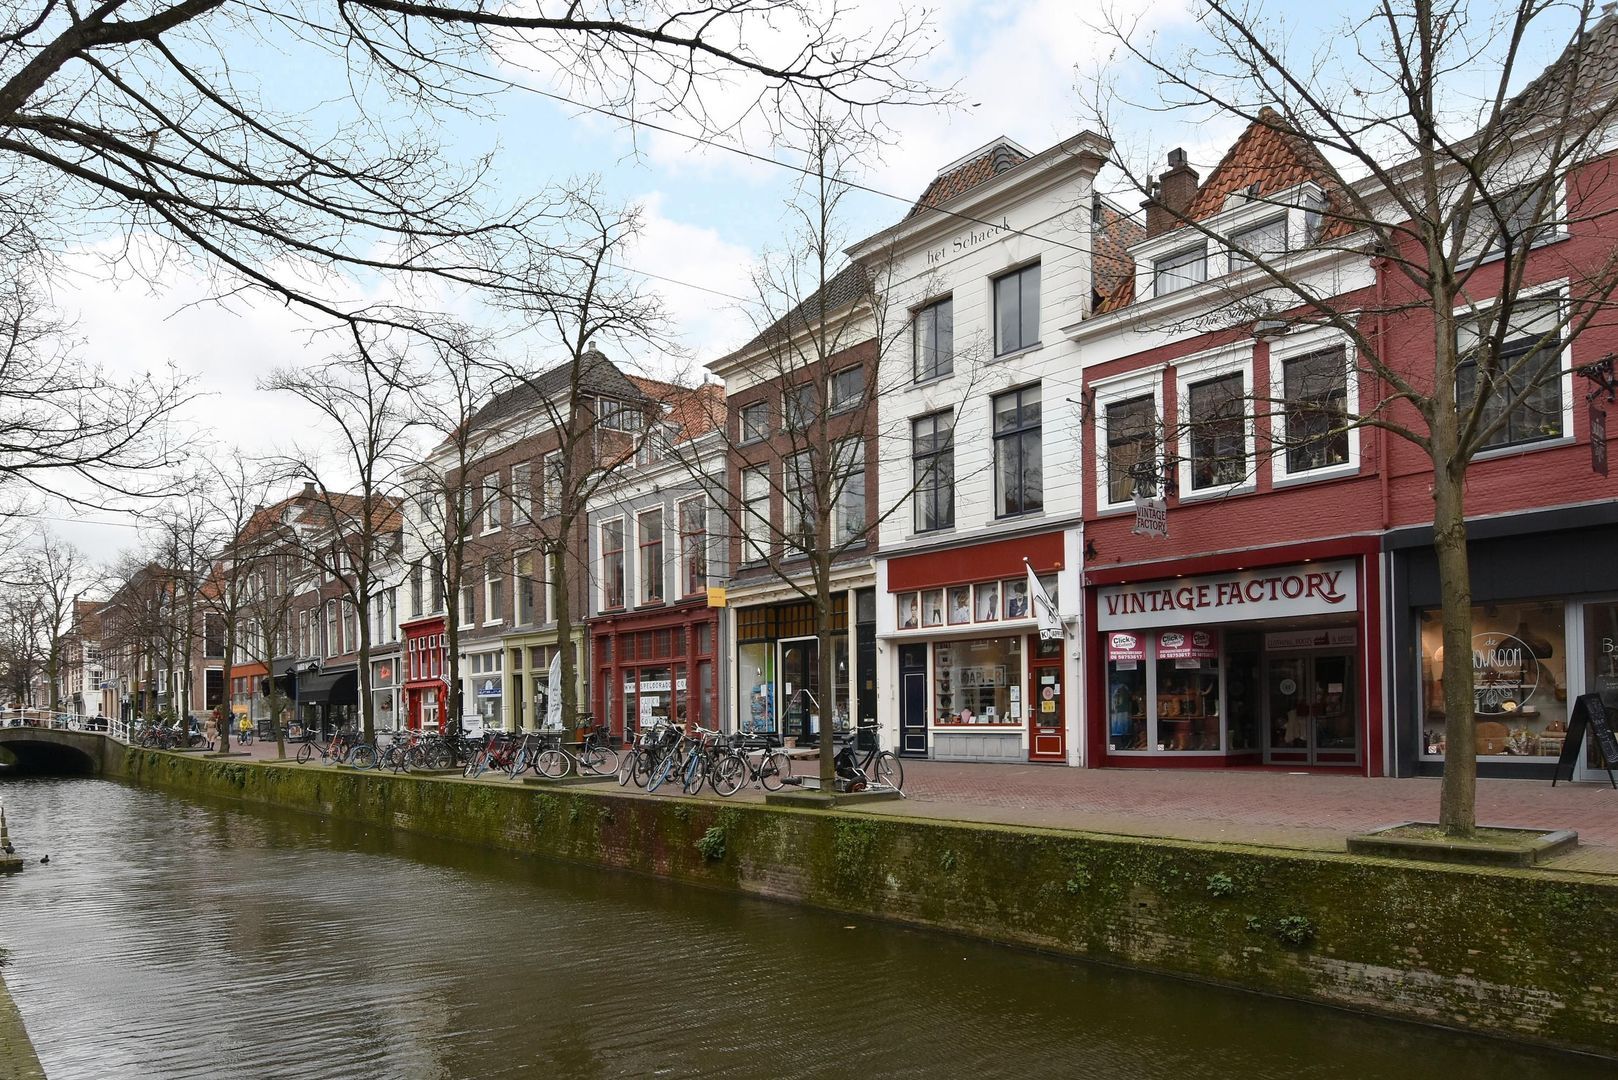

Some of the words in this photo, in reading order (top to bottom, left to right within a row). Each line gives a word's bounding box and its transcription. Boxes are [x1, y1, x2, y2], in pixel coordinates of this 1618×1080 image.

[927, 247, 945, 264] het
[1137, 506, 1166, 521] VINTAGE
[1137, 517, 1167, 534] FACTORY
[1104, 586, 1210, 615] VINTAGE
[1215, 571, 1346, 604] FACTORY
